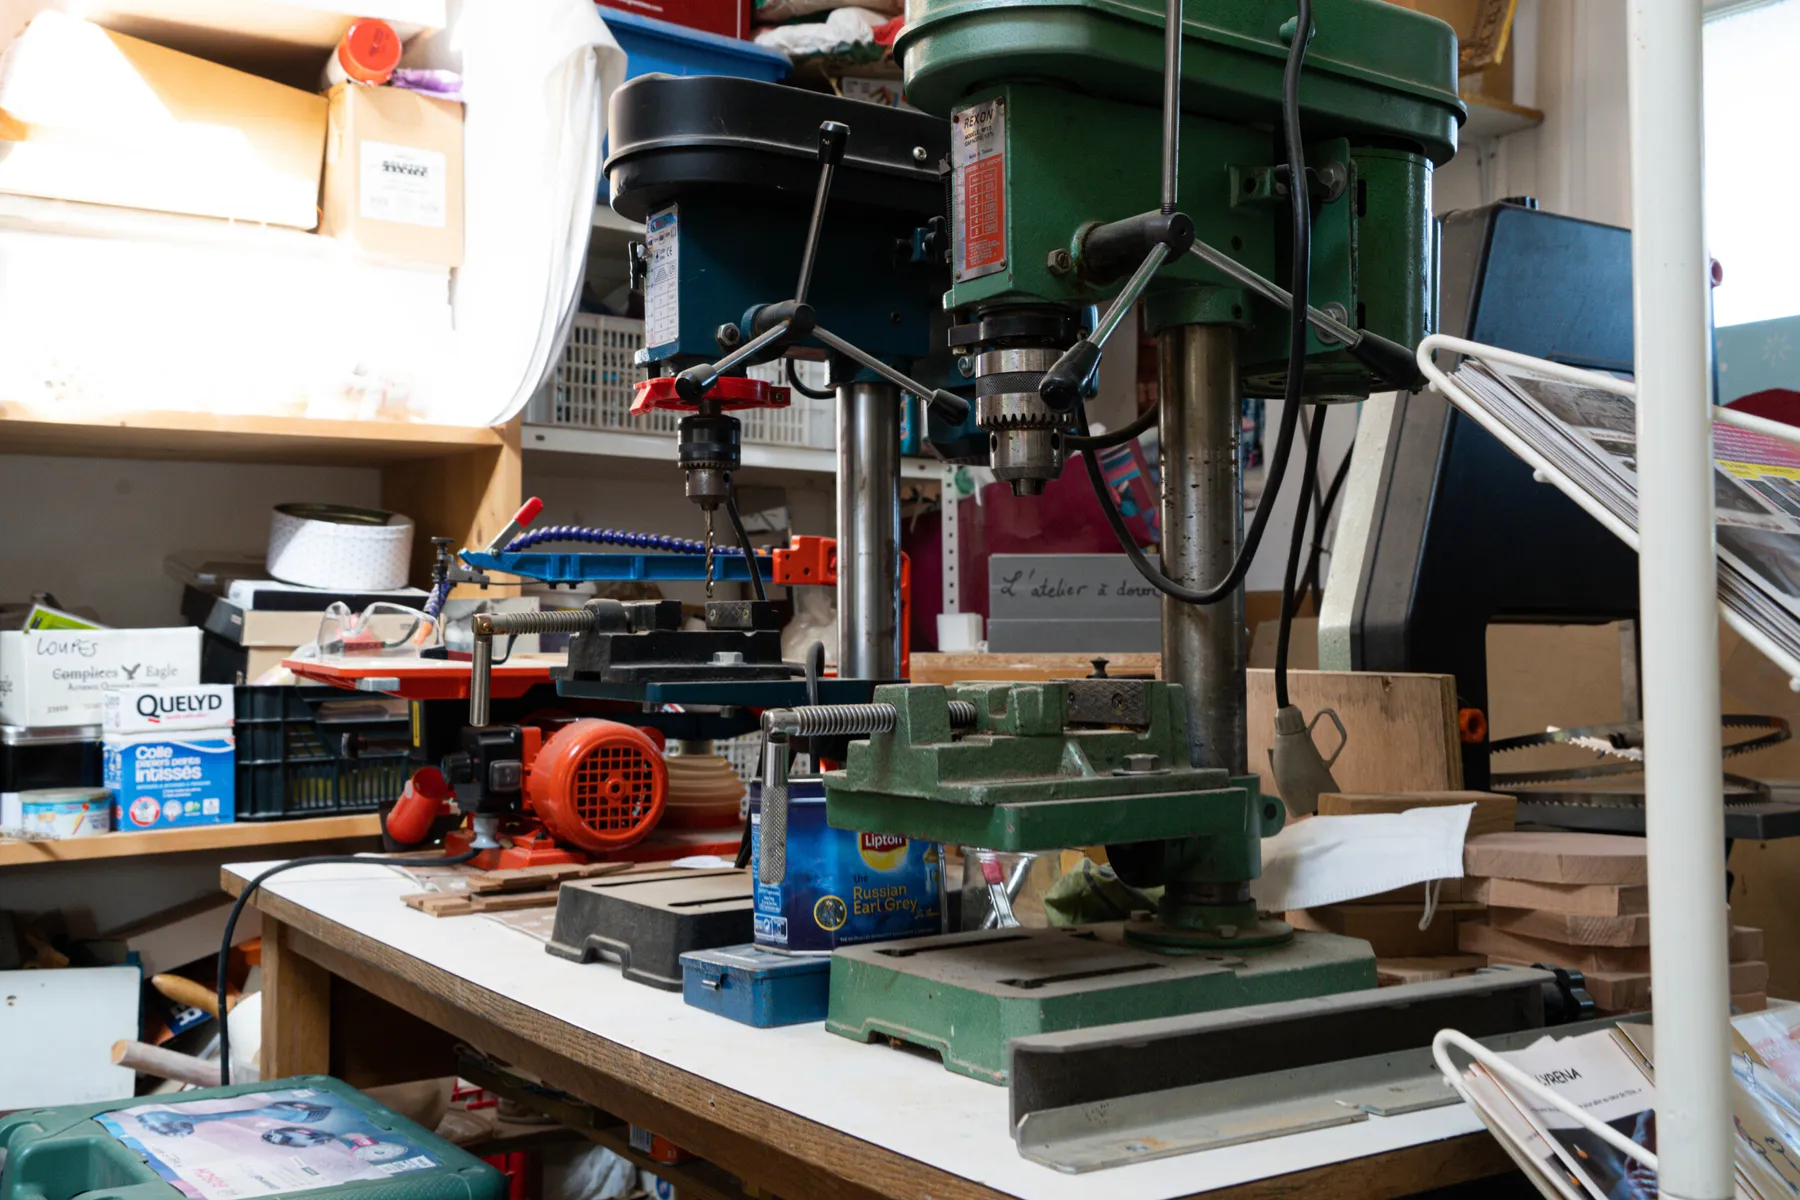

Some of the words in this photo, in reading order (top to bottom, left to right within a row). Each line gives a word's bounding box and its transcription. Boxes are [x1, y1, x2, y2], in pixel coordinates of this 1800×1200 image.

[964, 109, 993, 129] REXON
[1000, 568, 1088, 598] L'atelier
[1097, 583, 1108, 597] à
[52, 665, 118, 682] Complices
[146, 663, 178, 681] Eagle
[136, 694, 222, 718] QUELYD
[135, 745, 173, 760] Colle
[865, 833, 902, 849] Lipton
[854, 873, 868, 883] the
[853, 884, 907, 900] Russian
[853, 897, 882, 915] Earl
[884, 897, 918, 914] Grey
